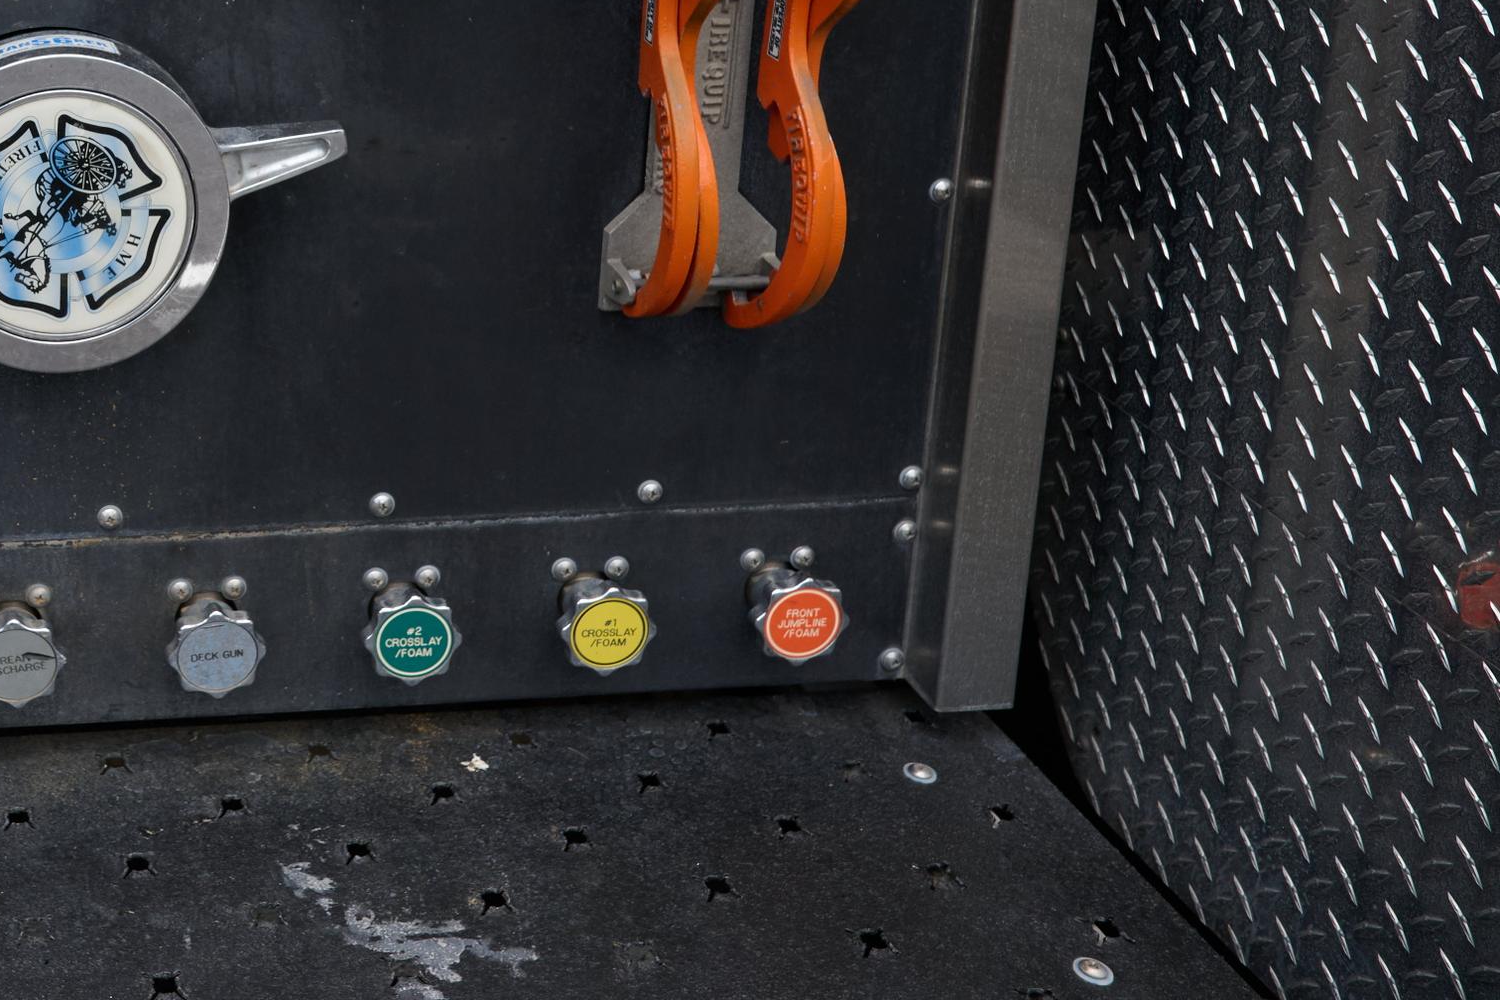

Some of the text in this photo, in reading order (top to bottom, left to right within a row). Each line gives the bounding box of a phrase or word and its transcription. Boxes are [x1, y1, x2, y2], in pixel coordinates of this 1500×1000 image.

[102, 233, 142, 280] HME
[786, 608, 821, 619] FRONT
[605, 618, 617, 627] #1
[777, 617, 828, 629] JUMPLINE
[407, 626, 422, 636] #2
[581, 627, 637, 639] CROSSLAY
[783, 627, 820, 639] /FOAM
[385, 635, 443, 649] CROSSLAY
[590, 637, 627, 648] /FOAM
[190, 648, 244, 663] DECK GUN
[395, 646, 433, 659] /FOAM
